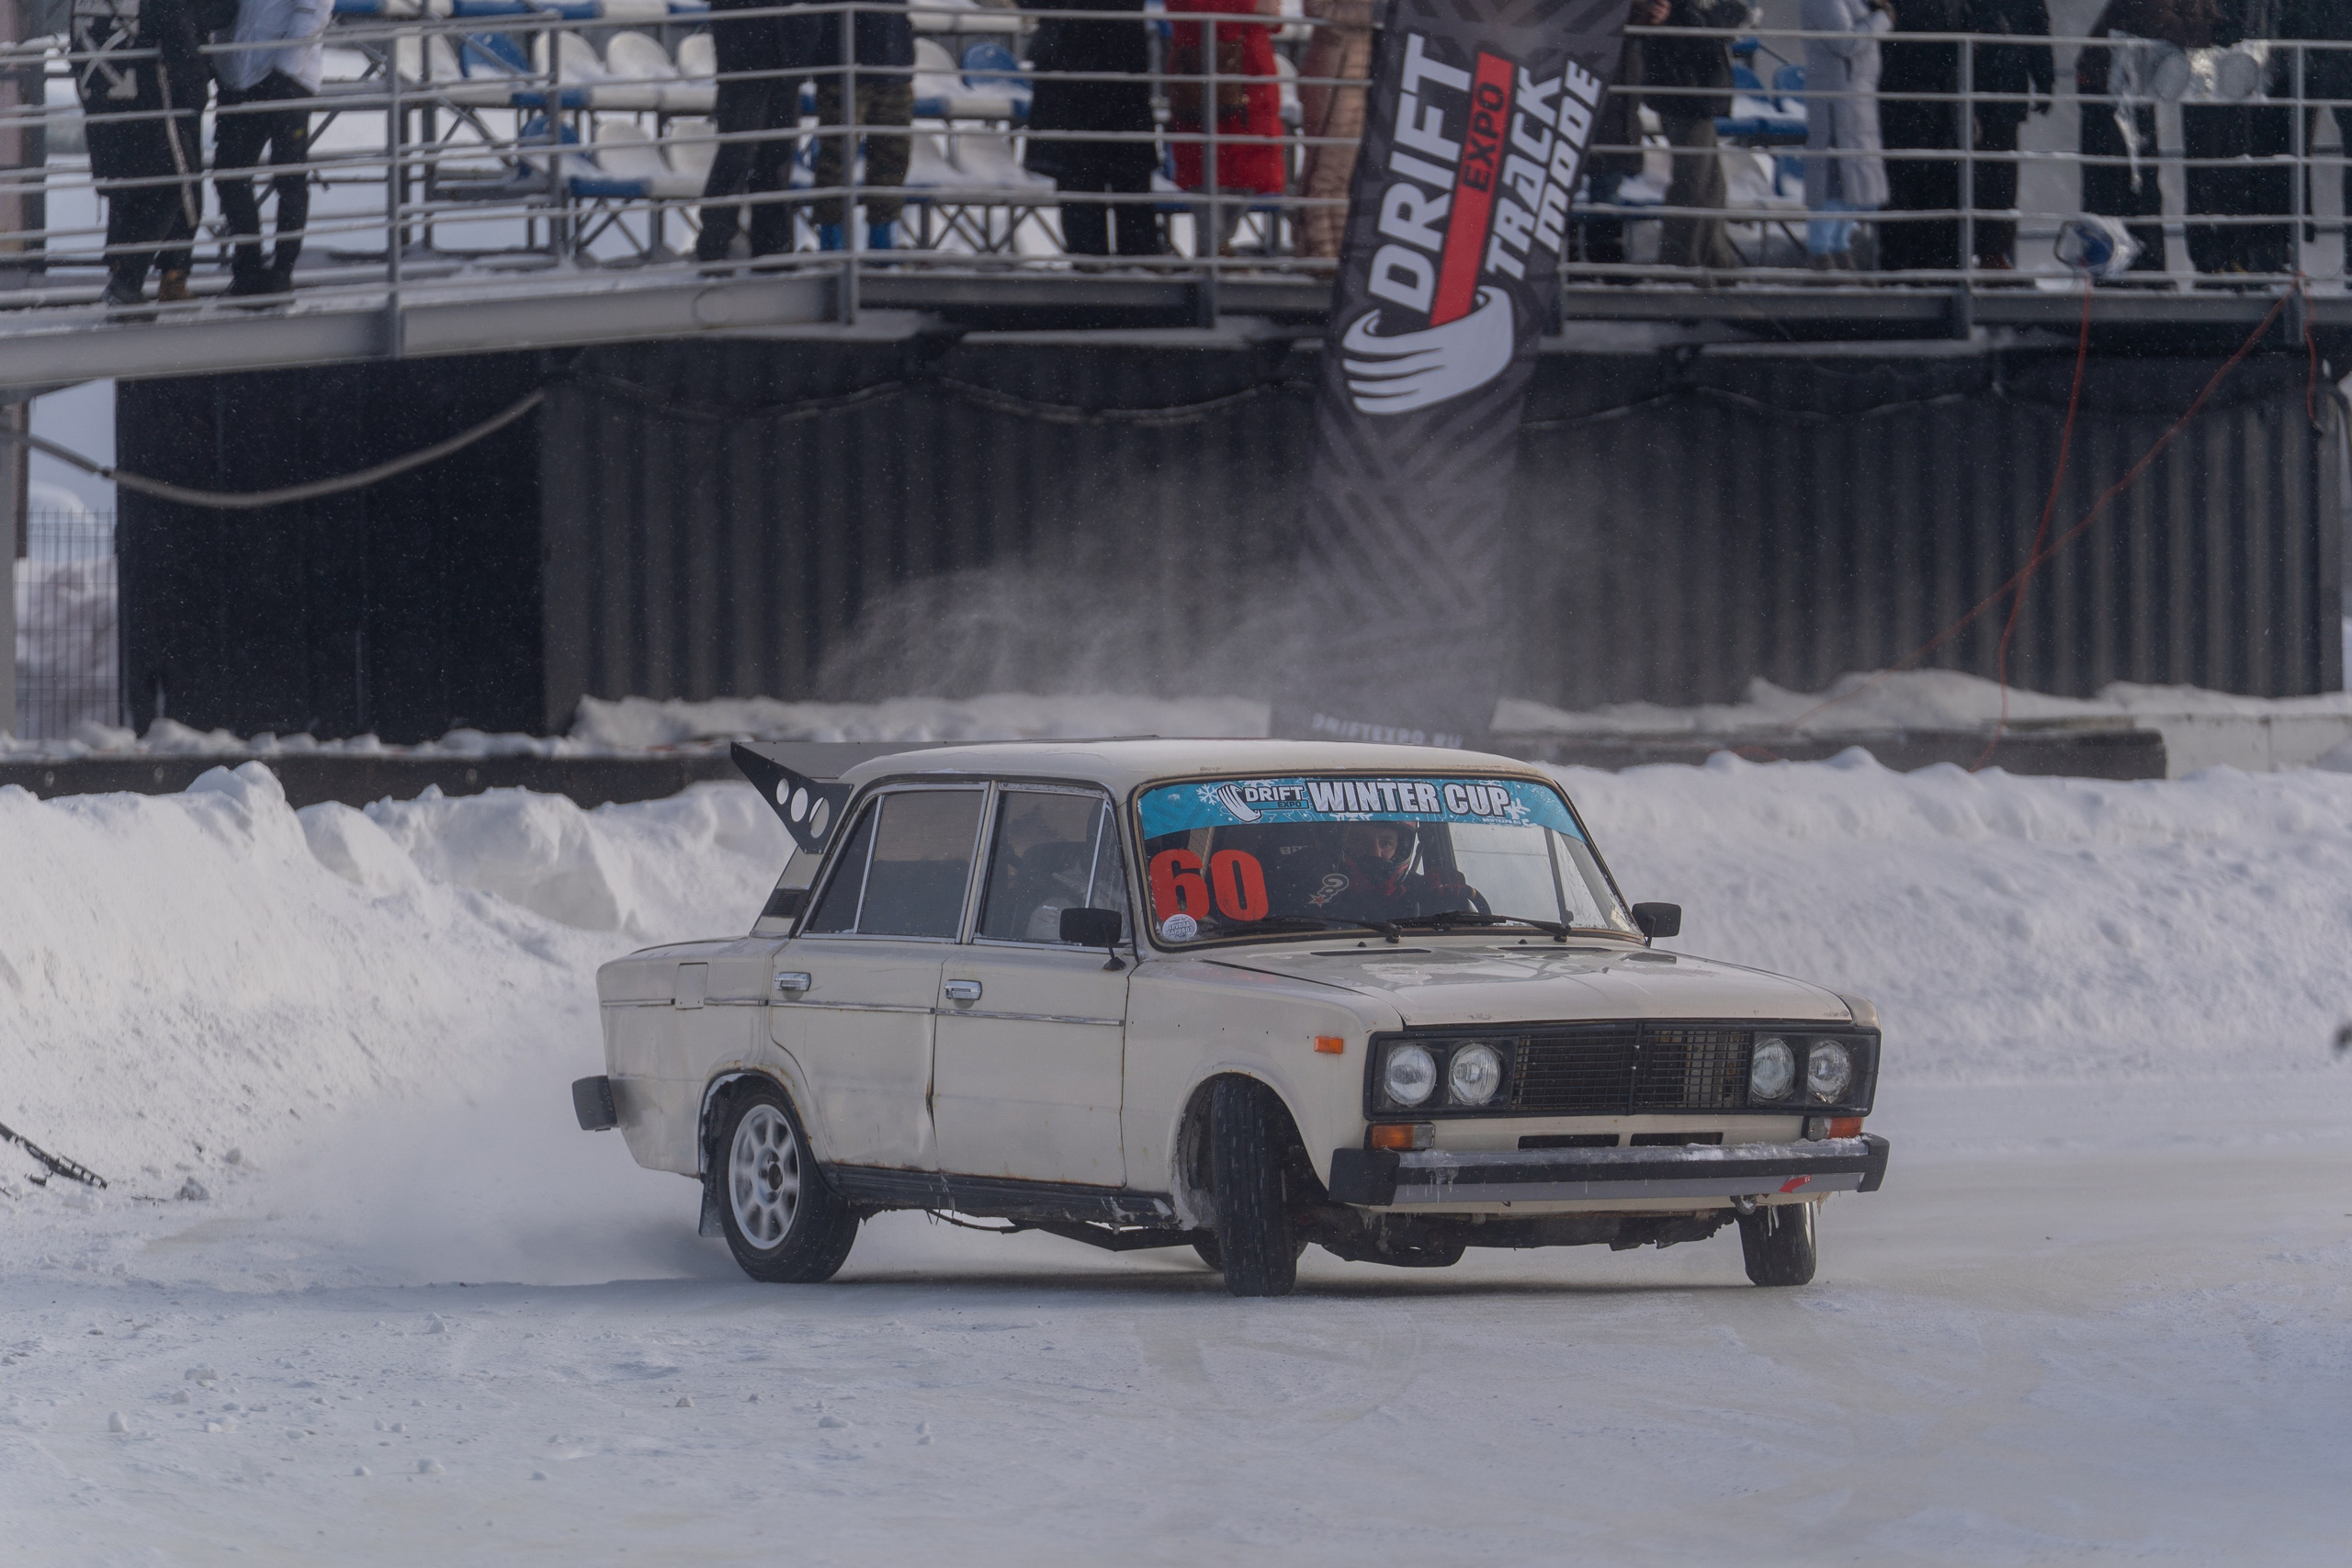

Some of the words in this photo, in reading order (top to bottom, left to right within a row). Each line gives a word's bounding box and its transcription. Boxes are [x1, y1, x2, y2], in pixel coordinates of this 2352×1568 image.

[1368, 33, 1472, 313] DRIFT
[1464, 81, 1505, 192] EXPO
[1485, 66, 1562, 279] TRACK
[1245, 785, 1304, 802] DRIFT
[1306, 781, 1442, 813] WINTER
[1443, 784, 1510, 817] CUP
[1149, 849, 1269, 921] 60
